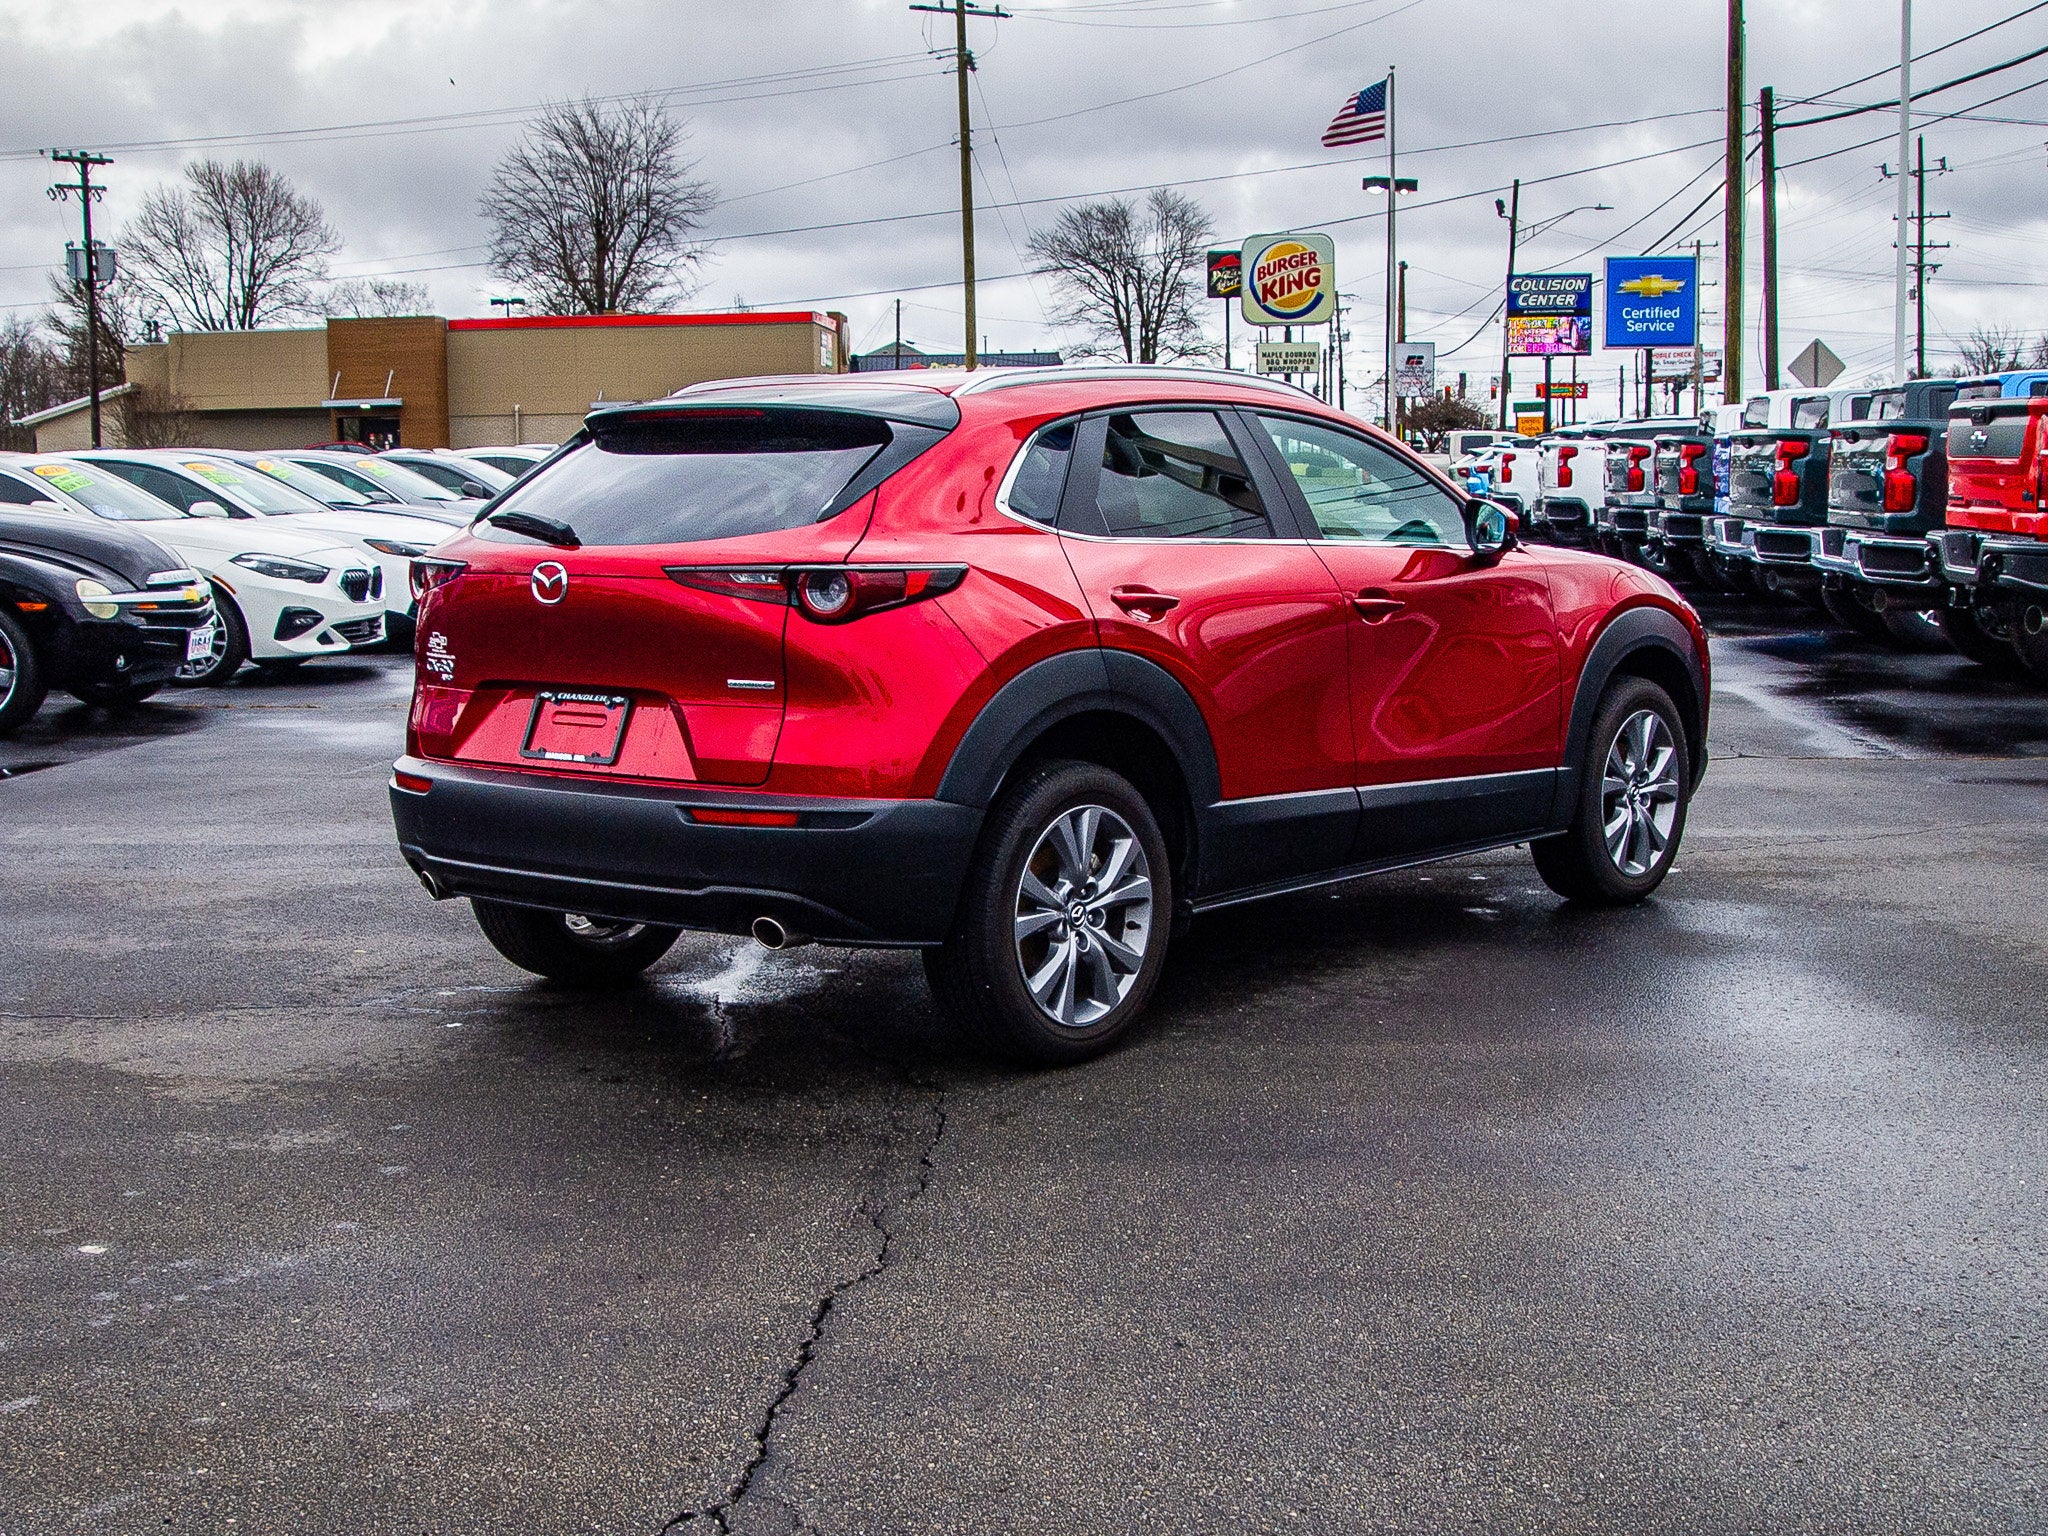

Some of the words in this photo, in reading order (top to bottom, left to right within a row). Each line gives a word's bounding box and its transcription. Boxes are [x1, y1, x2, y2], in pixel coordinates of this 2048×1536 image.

[1257, 250, 1318, 282] BURGER
[1261, 267, 1322, 304] KING
[1510, 278, 1587, 292] COLLISION
[1518, 293, 1576, 307] CENTER
[1622, 306, 1680, 319] Certified
[1626, 319, 1675, 332] Service
[1261, 351, 1283, 359] MAPLE
[557, 692, 608, 703] CHANDLER
